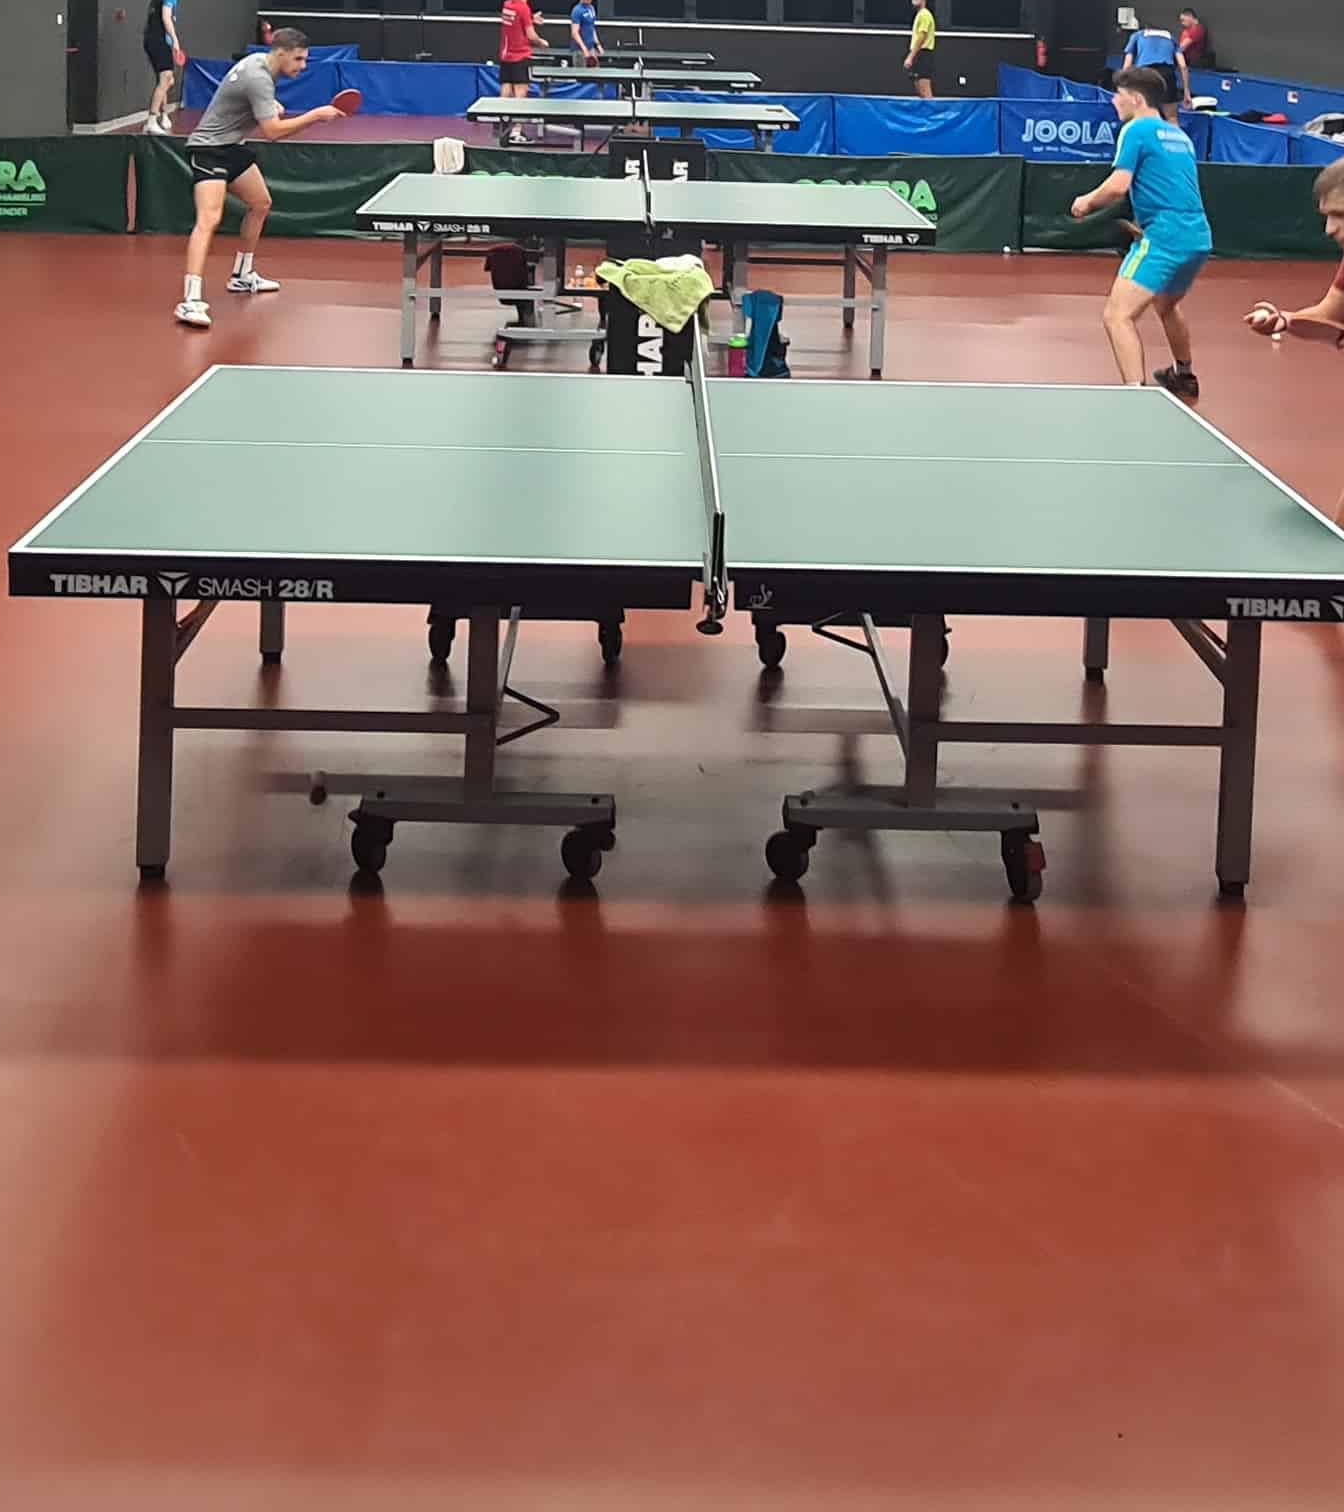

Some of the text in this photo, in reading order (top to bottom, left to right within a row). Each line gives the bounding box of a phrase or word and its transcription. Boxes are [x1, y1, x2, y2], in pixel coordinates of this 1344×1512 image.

[1021, 118, 1115, 145] JOOLA
[50, 573, 334, 599] TIBHAR SMASH 28/R
[1226, 597, 1321, 619] TIBHAR
